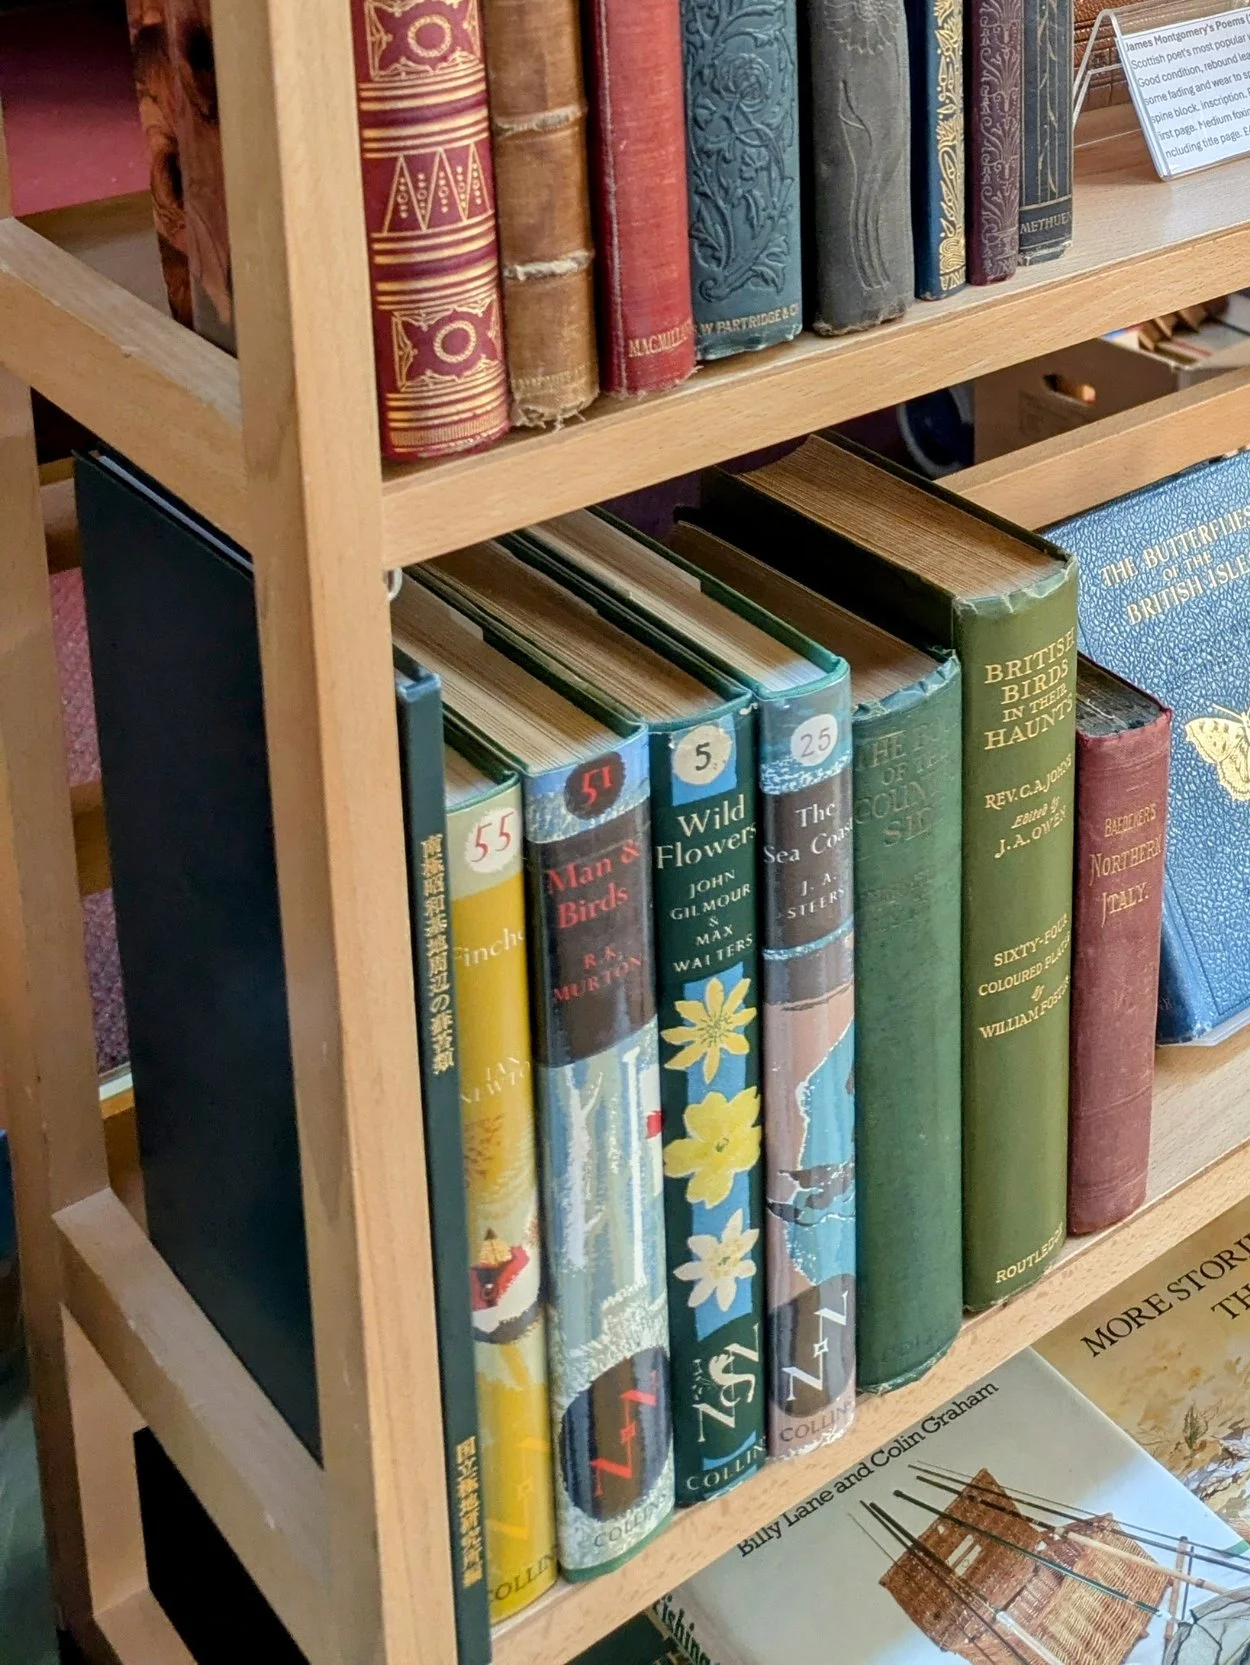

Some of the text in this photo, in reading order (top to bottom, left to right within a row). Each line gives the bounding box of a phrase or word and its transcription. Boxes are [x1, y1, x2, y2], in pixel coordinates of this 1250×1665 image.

[1125, 37, 1153, 52] James
[1154, 24, 1215, 46] Montgomery's
[1216, 18, 1245, 30] Poems
[1131, 54, 1166, 70] Scottish
[1167, 48, 1192, 64] poet's
[1193, 43, 1213, 55] most
[1215, 35, 1247, 51] popular
[1100, 556, 1138, 586] THE
[1163, 551, 1213, 581] OF THE
[1126, 576, 1203, 625] BRITISH
[984, 627, 1075, 685] BRITISH
[1001, 659, 1068, 704] BIRDS
[984, 692, 1073, 750] HAUNTS
[1003, 683, 1067, 723] IN THEIR
[696, 742, 711, 771] 5
[800, 727, 831, 757] 25
[582, 765, 612, 807] 51
[677, 794, 745, 838] Wild
[796, 803, 835, 827] The
[471, 811, 514, 862] 55
[656, 822, 756, 870] Flowers
[764, 846, 800, 863] Sea
[546, 838, 641, 894] Man &
[1088, 835, 1162, 886] NORTHERN
[670, 884, 751, 920] GILMOUR
[689, 869, 736, 899] JOHN
[787, 887, 844, 919] STEERS
[558, 883, 629, 929] Birds
[696, 924, 734, 947] MAX
[994, 912, 1067, 967] SIXTY-FOUR
[979, 963, 1042, 996] COLOURED
[979, 1007, 1039, 1038] WILLIAM
[1080, 1293, 1173, 1358] MORE
[737, 1381, 999, 1558] Billy Lane and Colin Graham
